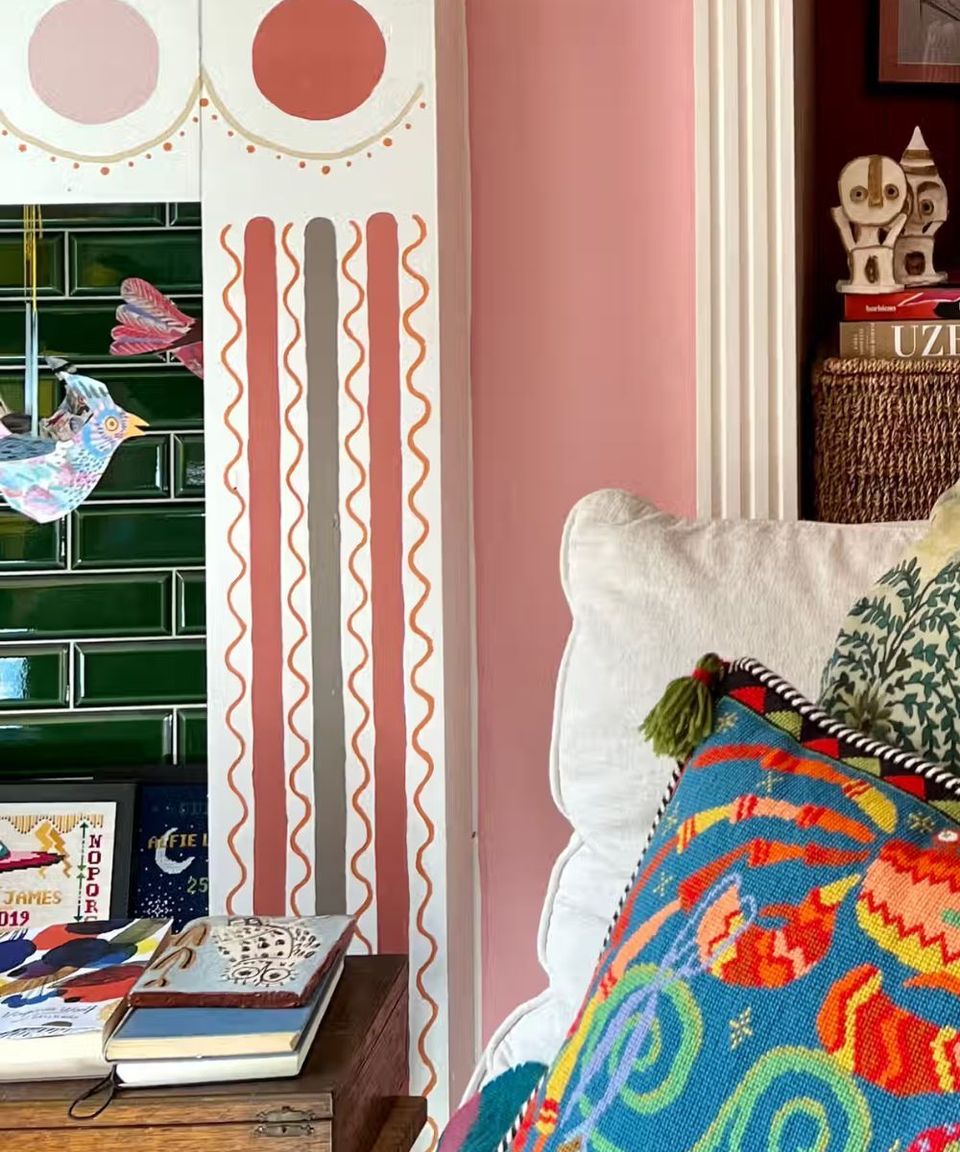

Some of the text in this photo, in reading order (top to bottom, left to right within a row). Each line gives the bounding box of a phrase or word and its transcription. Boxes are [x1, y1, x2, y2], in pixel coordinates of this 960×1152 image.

[865, 304, 897, 313] barbican
[147, 833, 198, 850] ALFIE
[3, 889, 63, 906] JAMES
